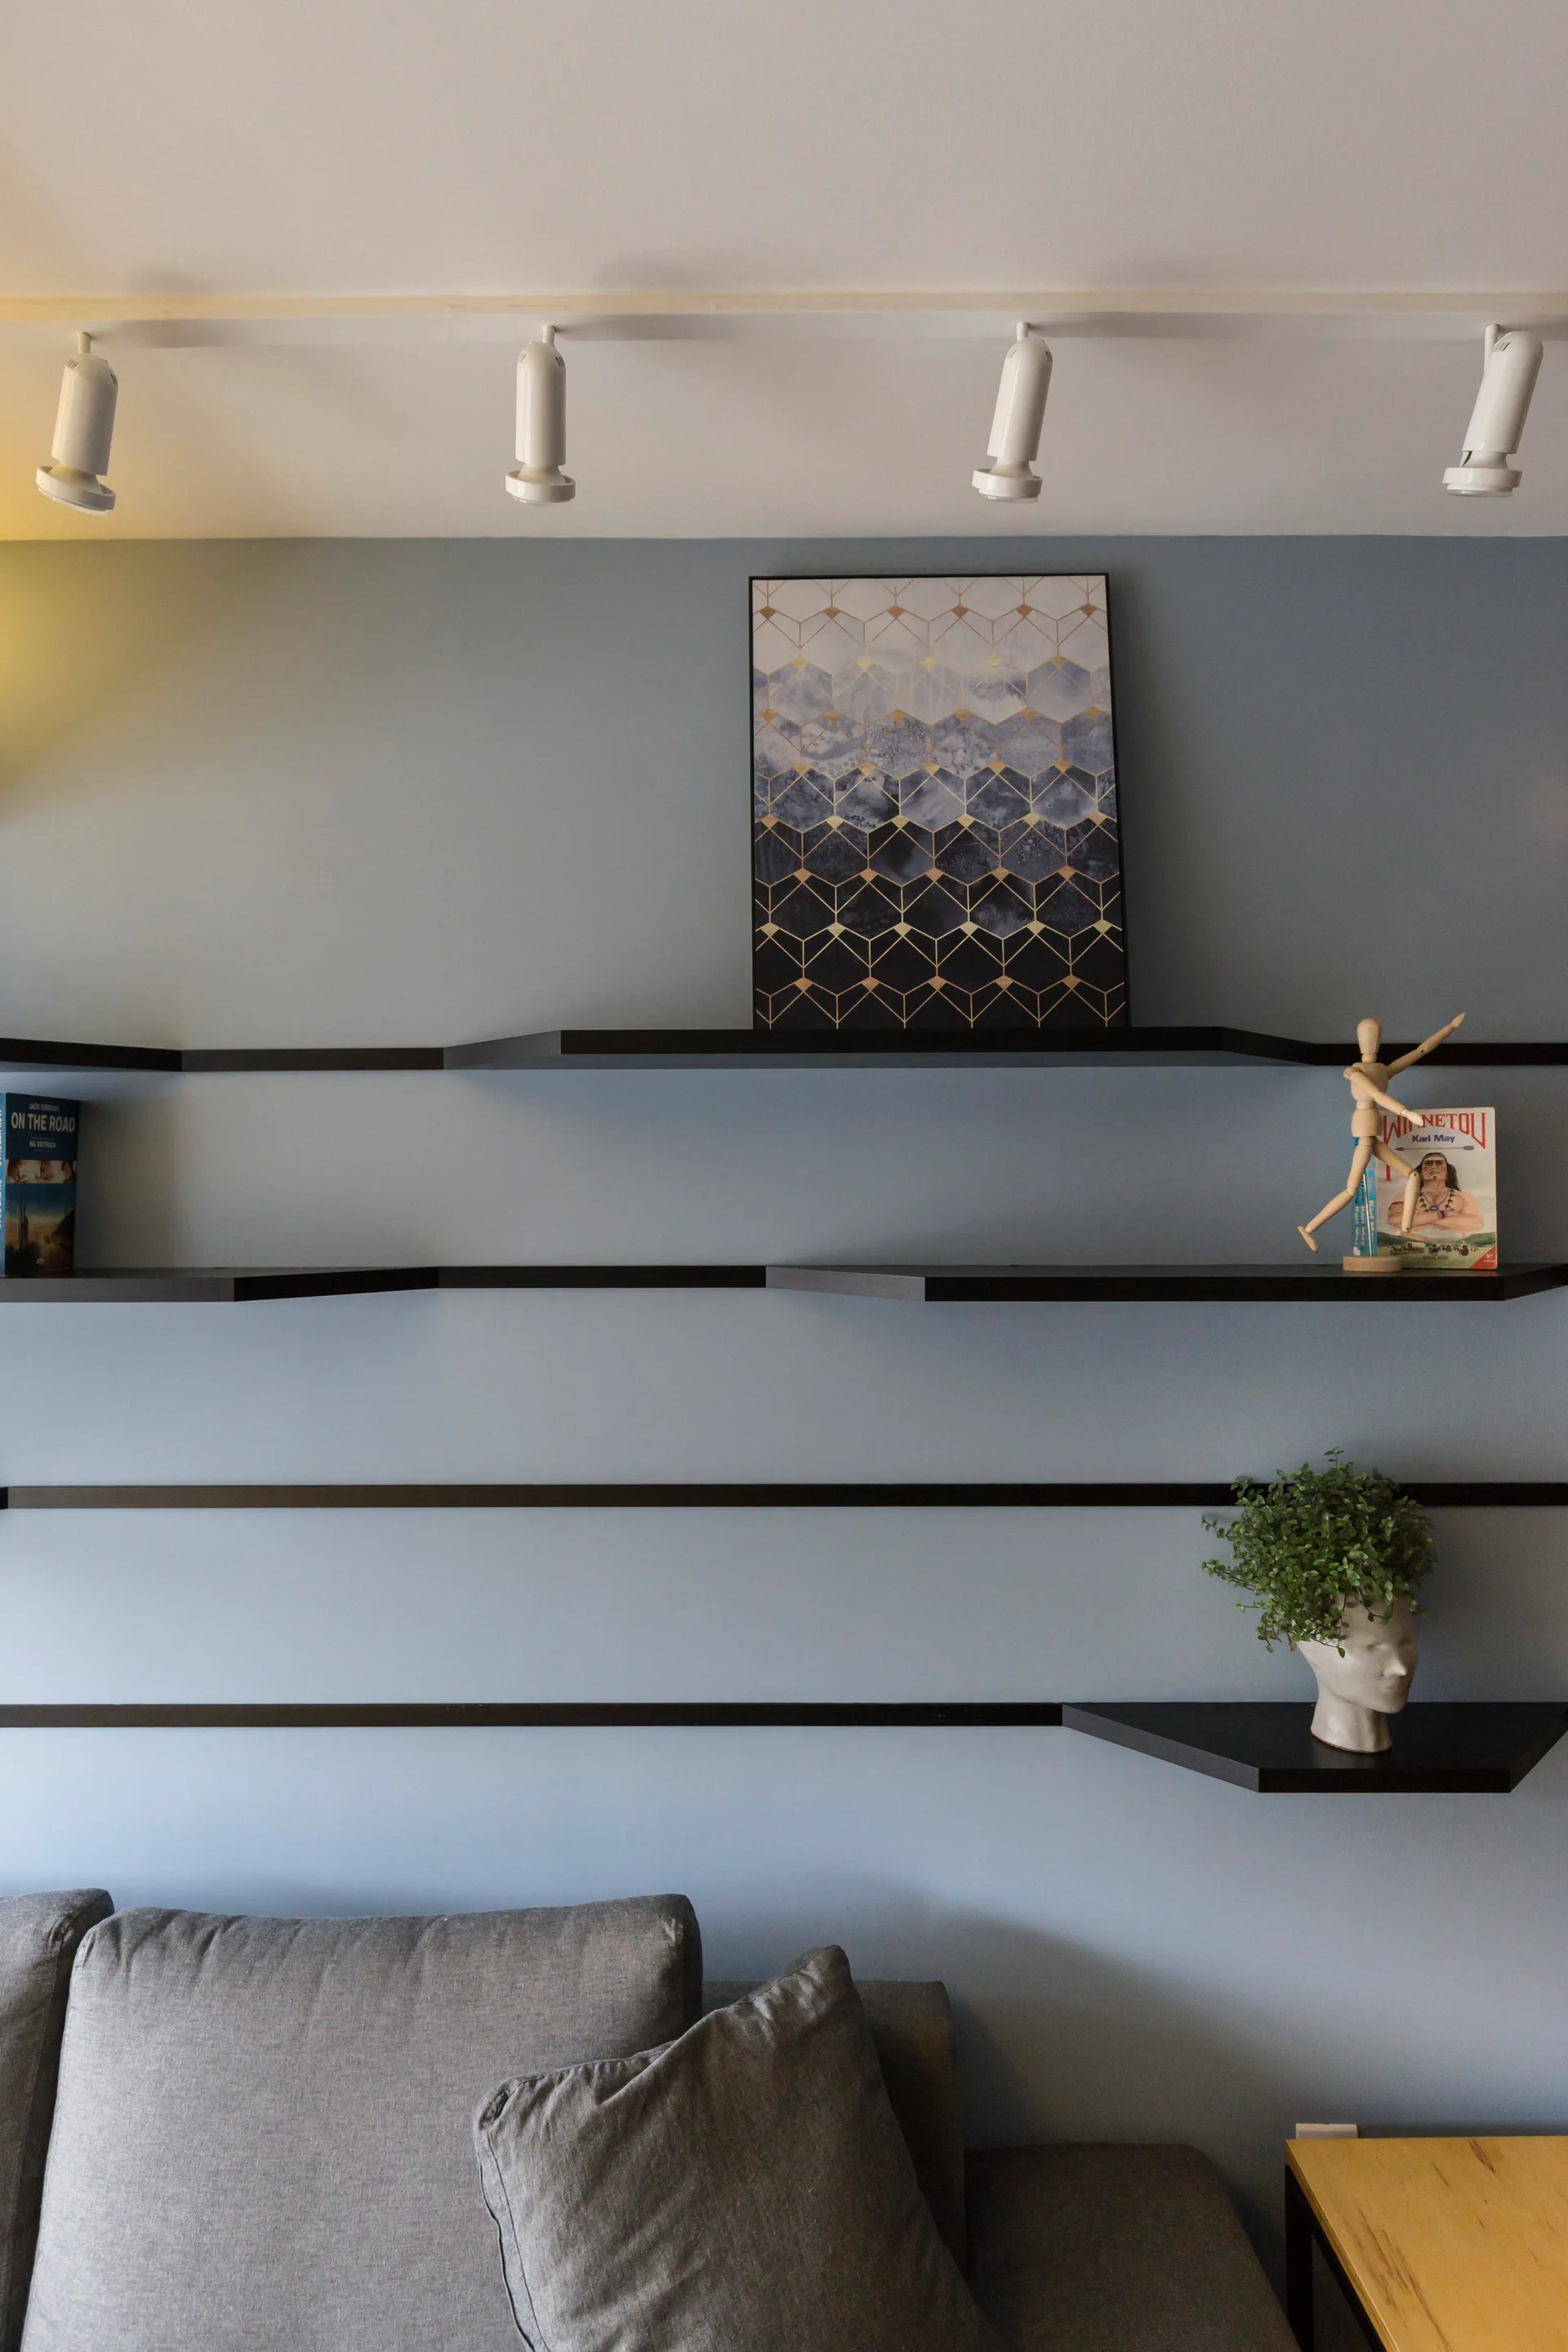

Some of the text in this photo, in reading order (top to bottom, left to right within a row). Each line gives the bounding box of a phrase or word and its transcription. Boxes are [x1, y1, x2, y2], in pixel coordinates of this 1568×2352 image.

[11, 1111, 75, 1134] ON THE ROAD
[1433, 1134, 1455, 1143] May
